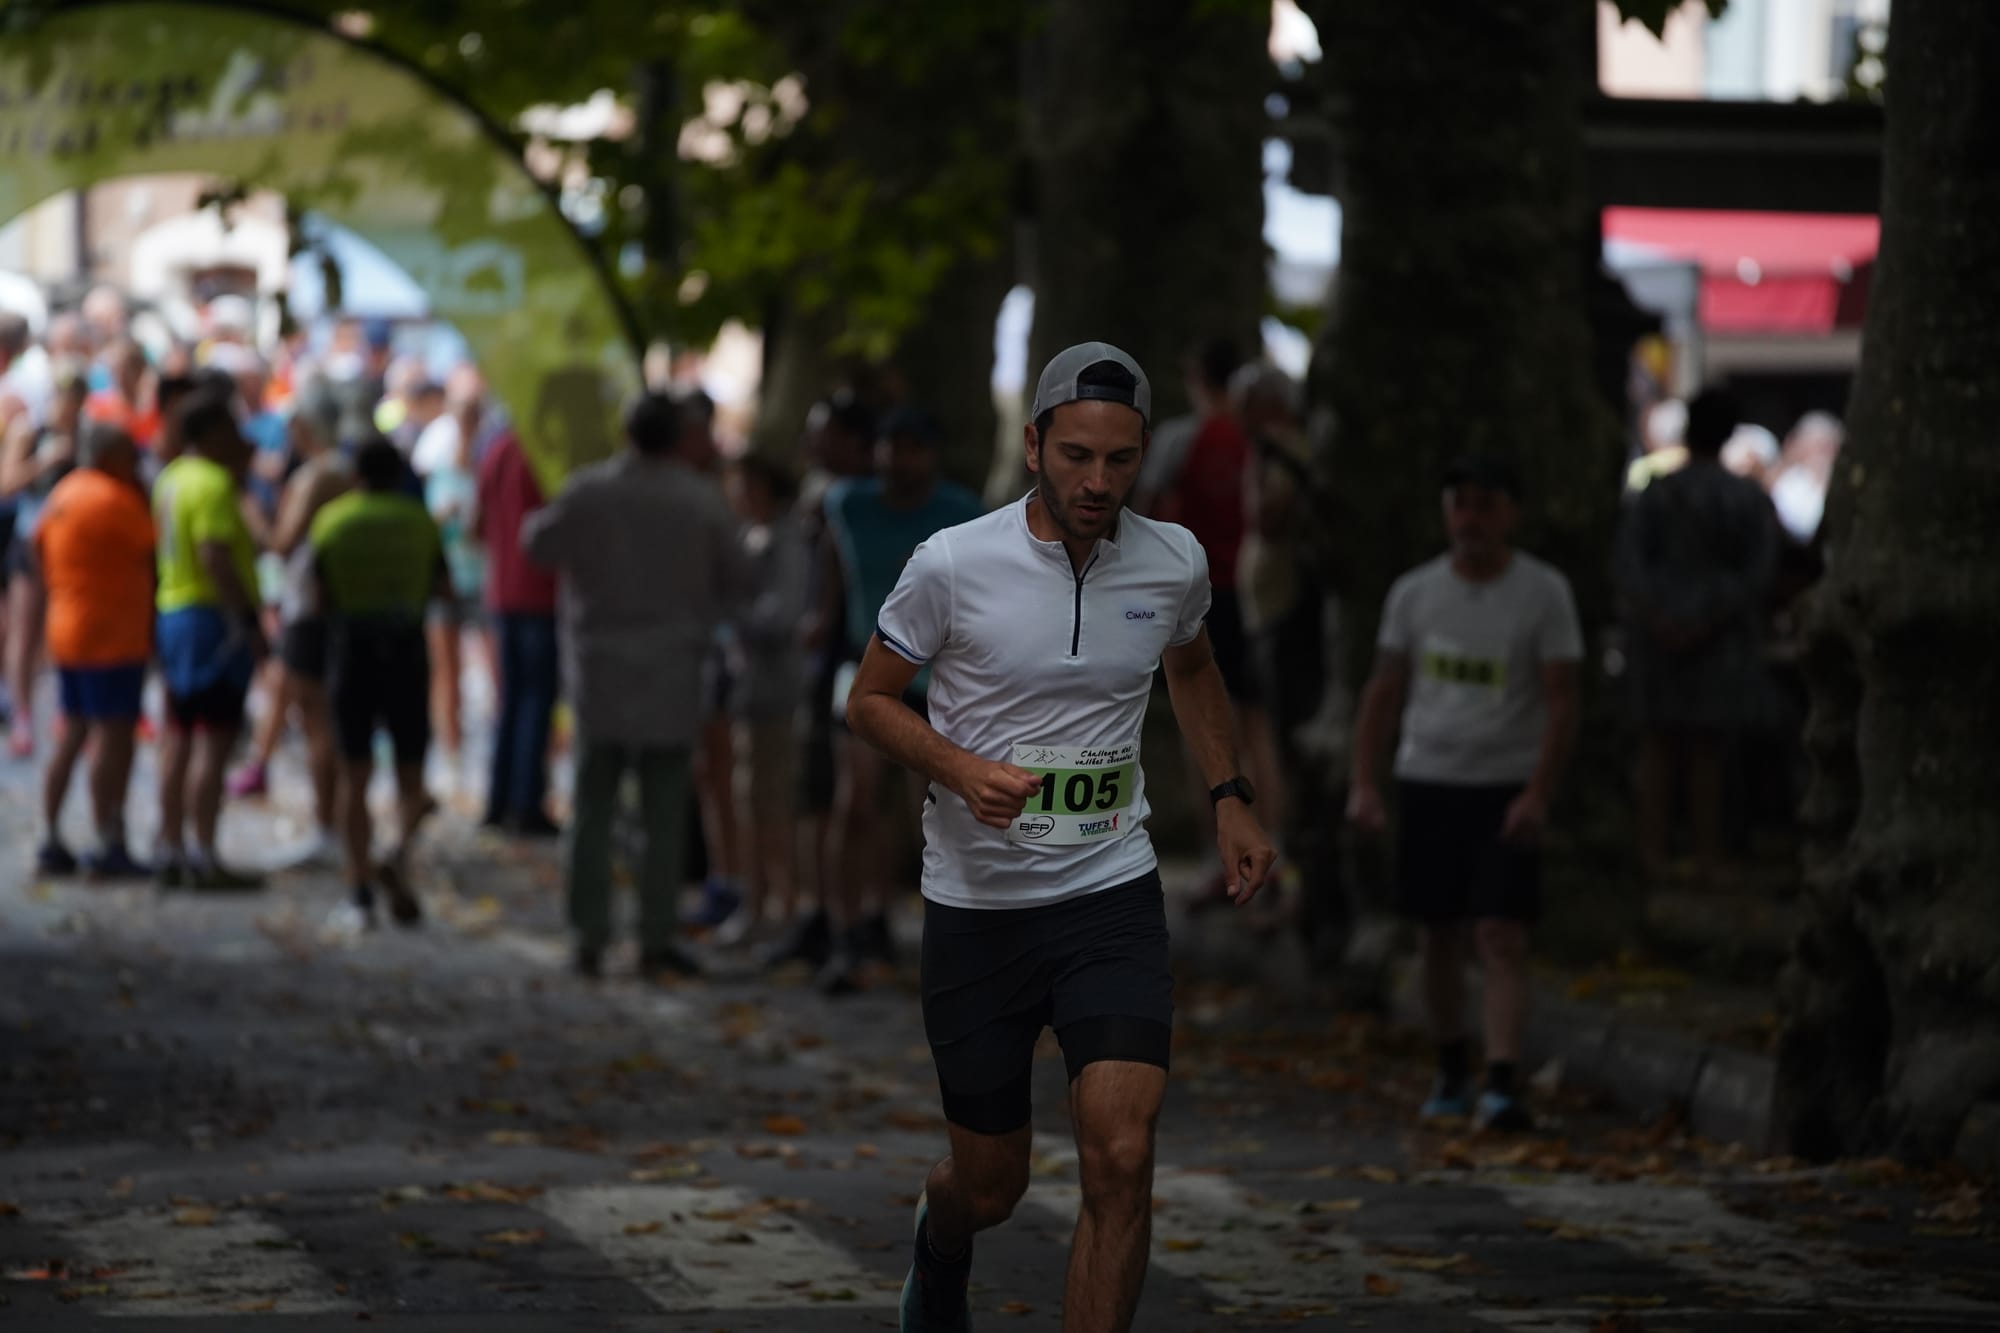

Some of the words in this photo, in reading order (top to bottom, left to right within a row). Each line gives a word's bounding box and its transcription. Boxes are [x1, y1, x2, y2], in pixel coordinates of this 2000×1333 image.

[1080, 749, 1118, 760] Challenge
[1040, 770, 1121, 812] 105
[1019, 823, 1050, 832] BFP
[1078, 819, 1110, 832] TUFF'S
